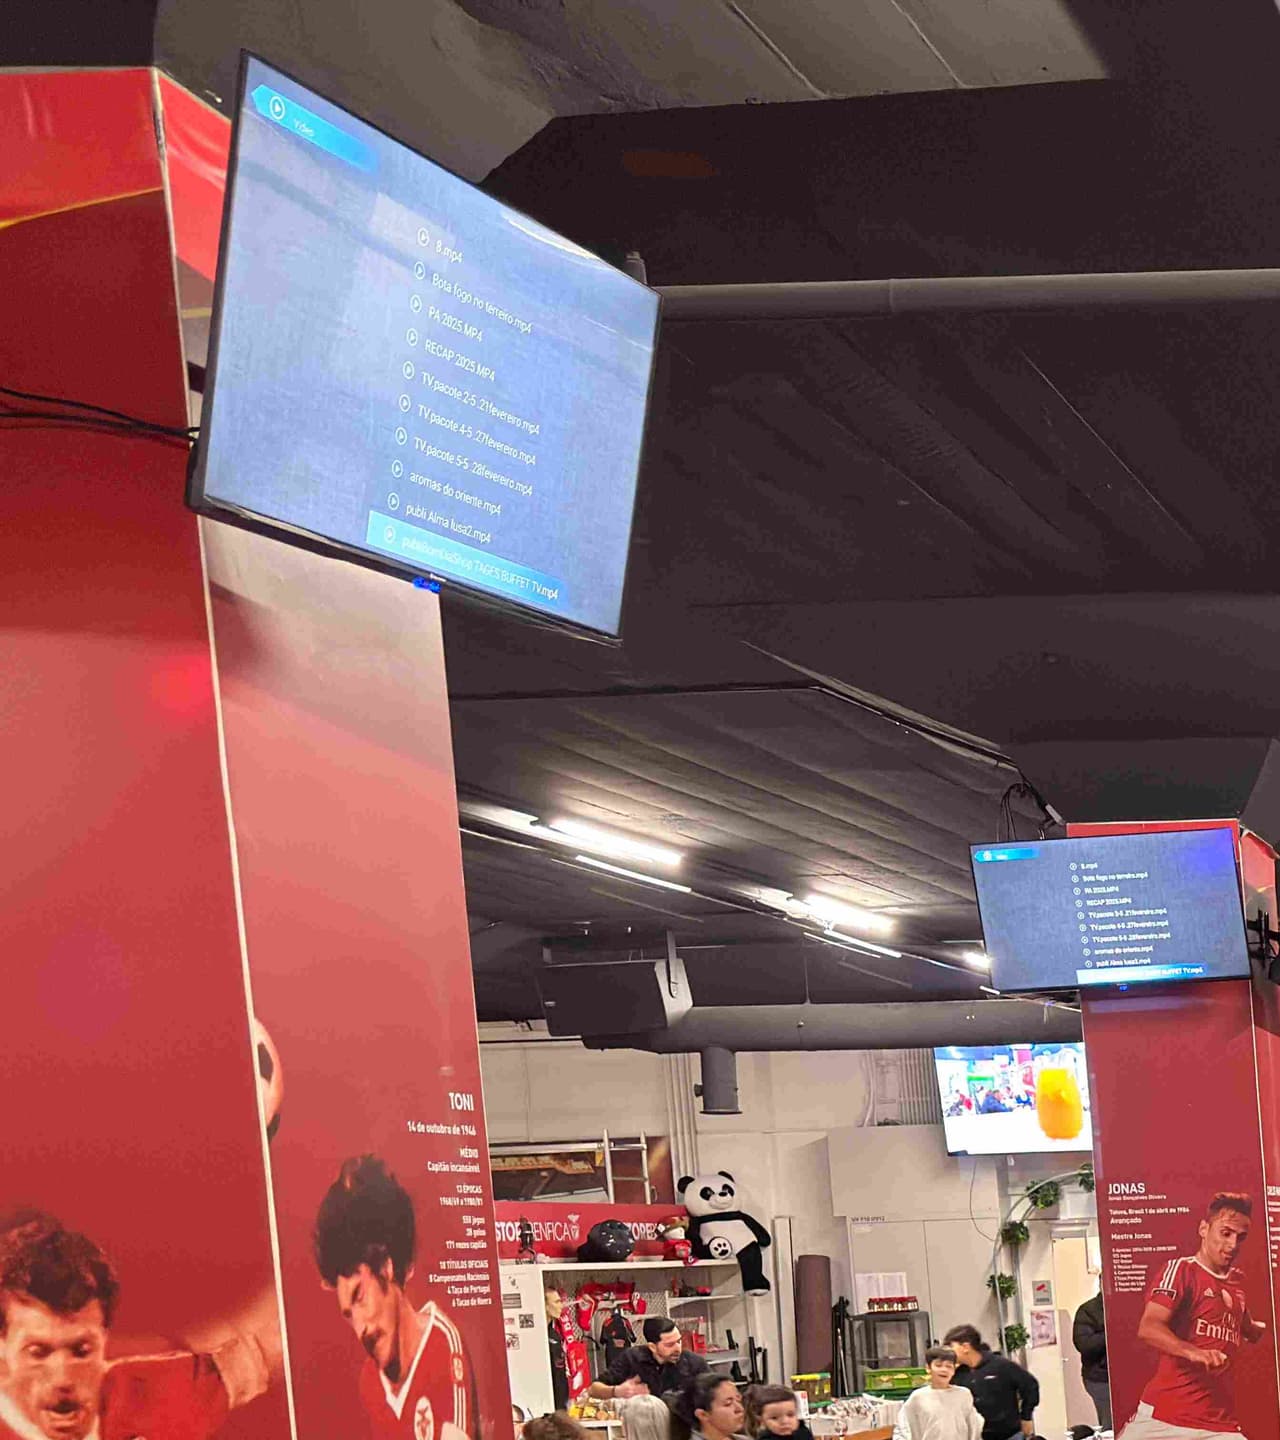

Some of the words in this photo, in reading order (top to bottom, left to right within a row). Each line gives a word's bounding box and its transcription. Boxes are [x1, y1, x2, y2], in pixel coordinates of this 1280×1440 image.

[435, 240, 463, 263] 8.mp4
[432, 273, 451, 293] Bota
[453, 283, 472, 304] fogo
[473, 297, 484, 310] no
[428, 306, 440, 321] PA
[442, 313, 483, 343] 2025.MP4
[424, 339, 455, 362] RECAP
[455, 354, 496, 382] 2025.MP4
[459, 422, 473, 439] 4-5
[456, 455, 469, 470] 5-5
[409, 471, 442, 493] aromas
[442, 483, 454, 498] do
[455, 489, 502, 515] oriente.mp4
[405, 503, 427, 521] publi
[428, 512, 450, 529] Alma
[531, 580, 559, 600] TV.mp4
[449, 1092, 474, 1111] TONI
[407, 1120, 417, 1133] 14
[417, 1122, 426, 1133] de
[426, 1123, 452, 1135] outubro
[452, 1124, 461, 1135] de
[459, 1146, 479, 1159] MÉDIO
[427, 1160, 450, 1174] Capitão
[1108, 1183, 1145, 1194] JONAS
[1110, 1217, 1142, 1225] Avançado
